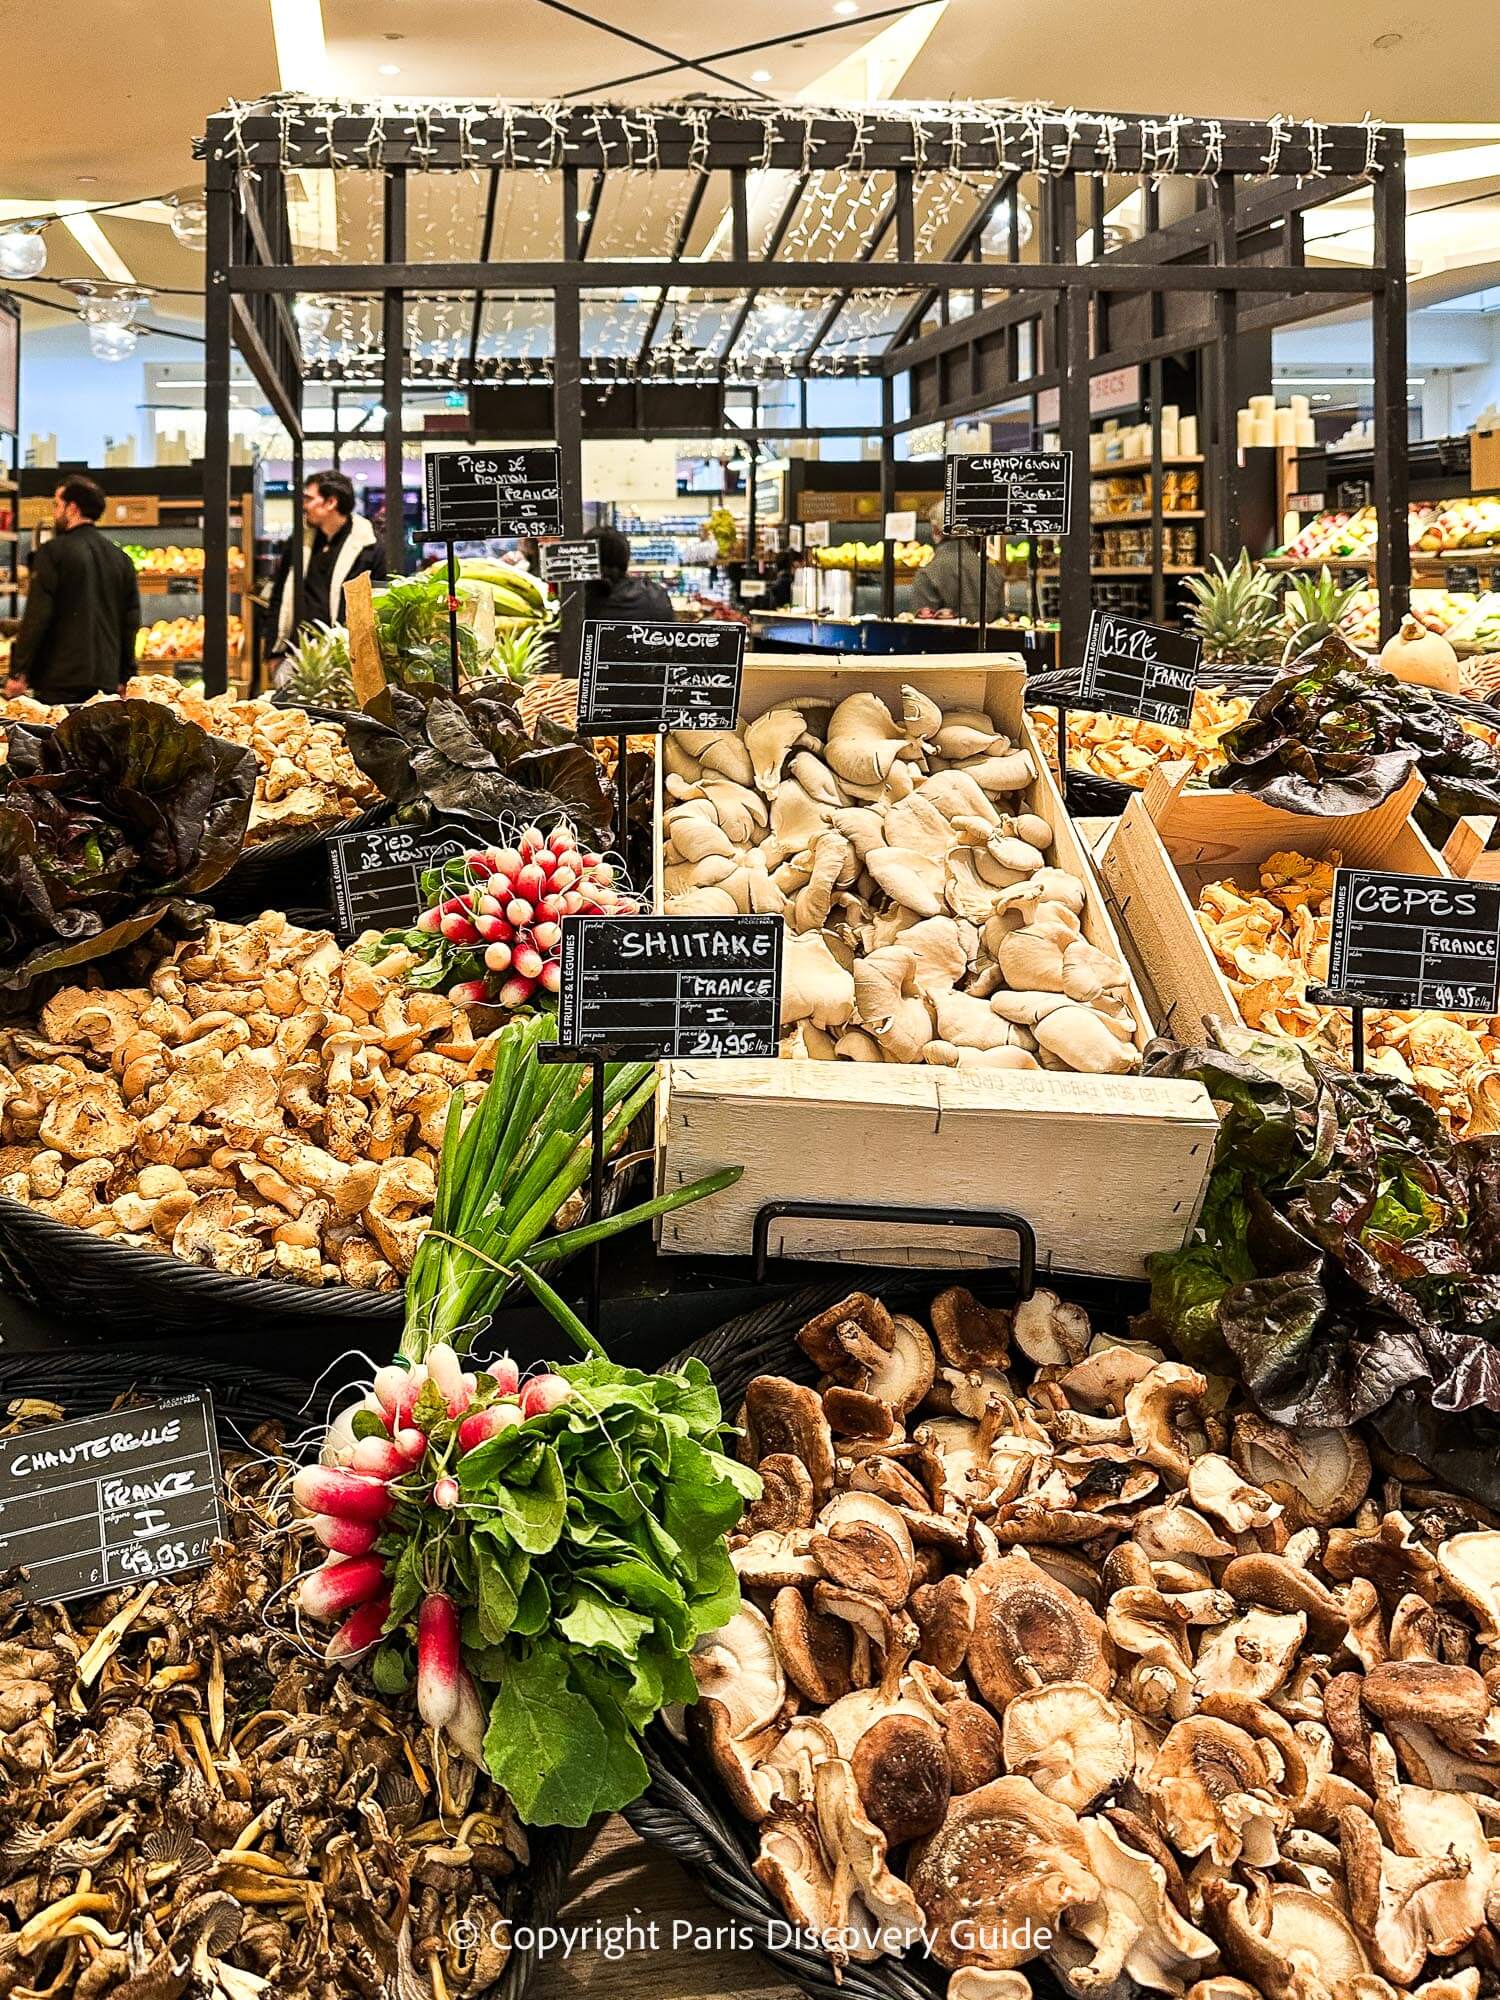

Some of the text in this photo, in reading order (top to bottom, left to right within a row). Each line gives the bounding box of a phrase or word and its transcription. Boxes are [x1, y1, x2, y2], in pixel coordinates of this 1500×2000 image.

[504, 488, 559, 502] FRANCE
[626, 625, 720, 647] PLEUROTE
[1102, 621, 1158, 661] CEPE
[1152, 666, 1198, 691] FRANCE
[1355, 886, 1476, 915] CEPES
[620, 931, 772, 957] SHIITAKE
[1429, 937, 1496, 955] FRANCE
[694, 978, 772, 996] FRANCE
[564, 993, 573, 1027] FRUITS
[706, 1007, 728, 1023] I
[563, 1030, 572, 1045] LES
[103, 1470, 196, 1509] FRANCE
[133, 1509, 171, 1537] I
